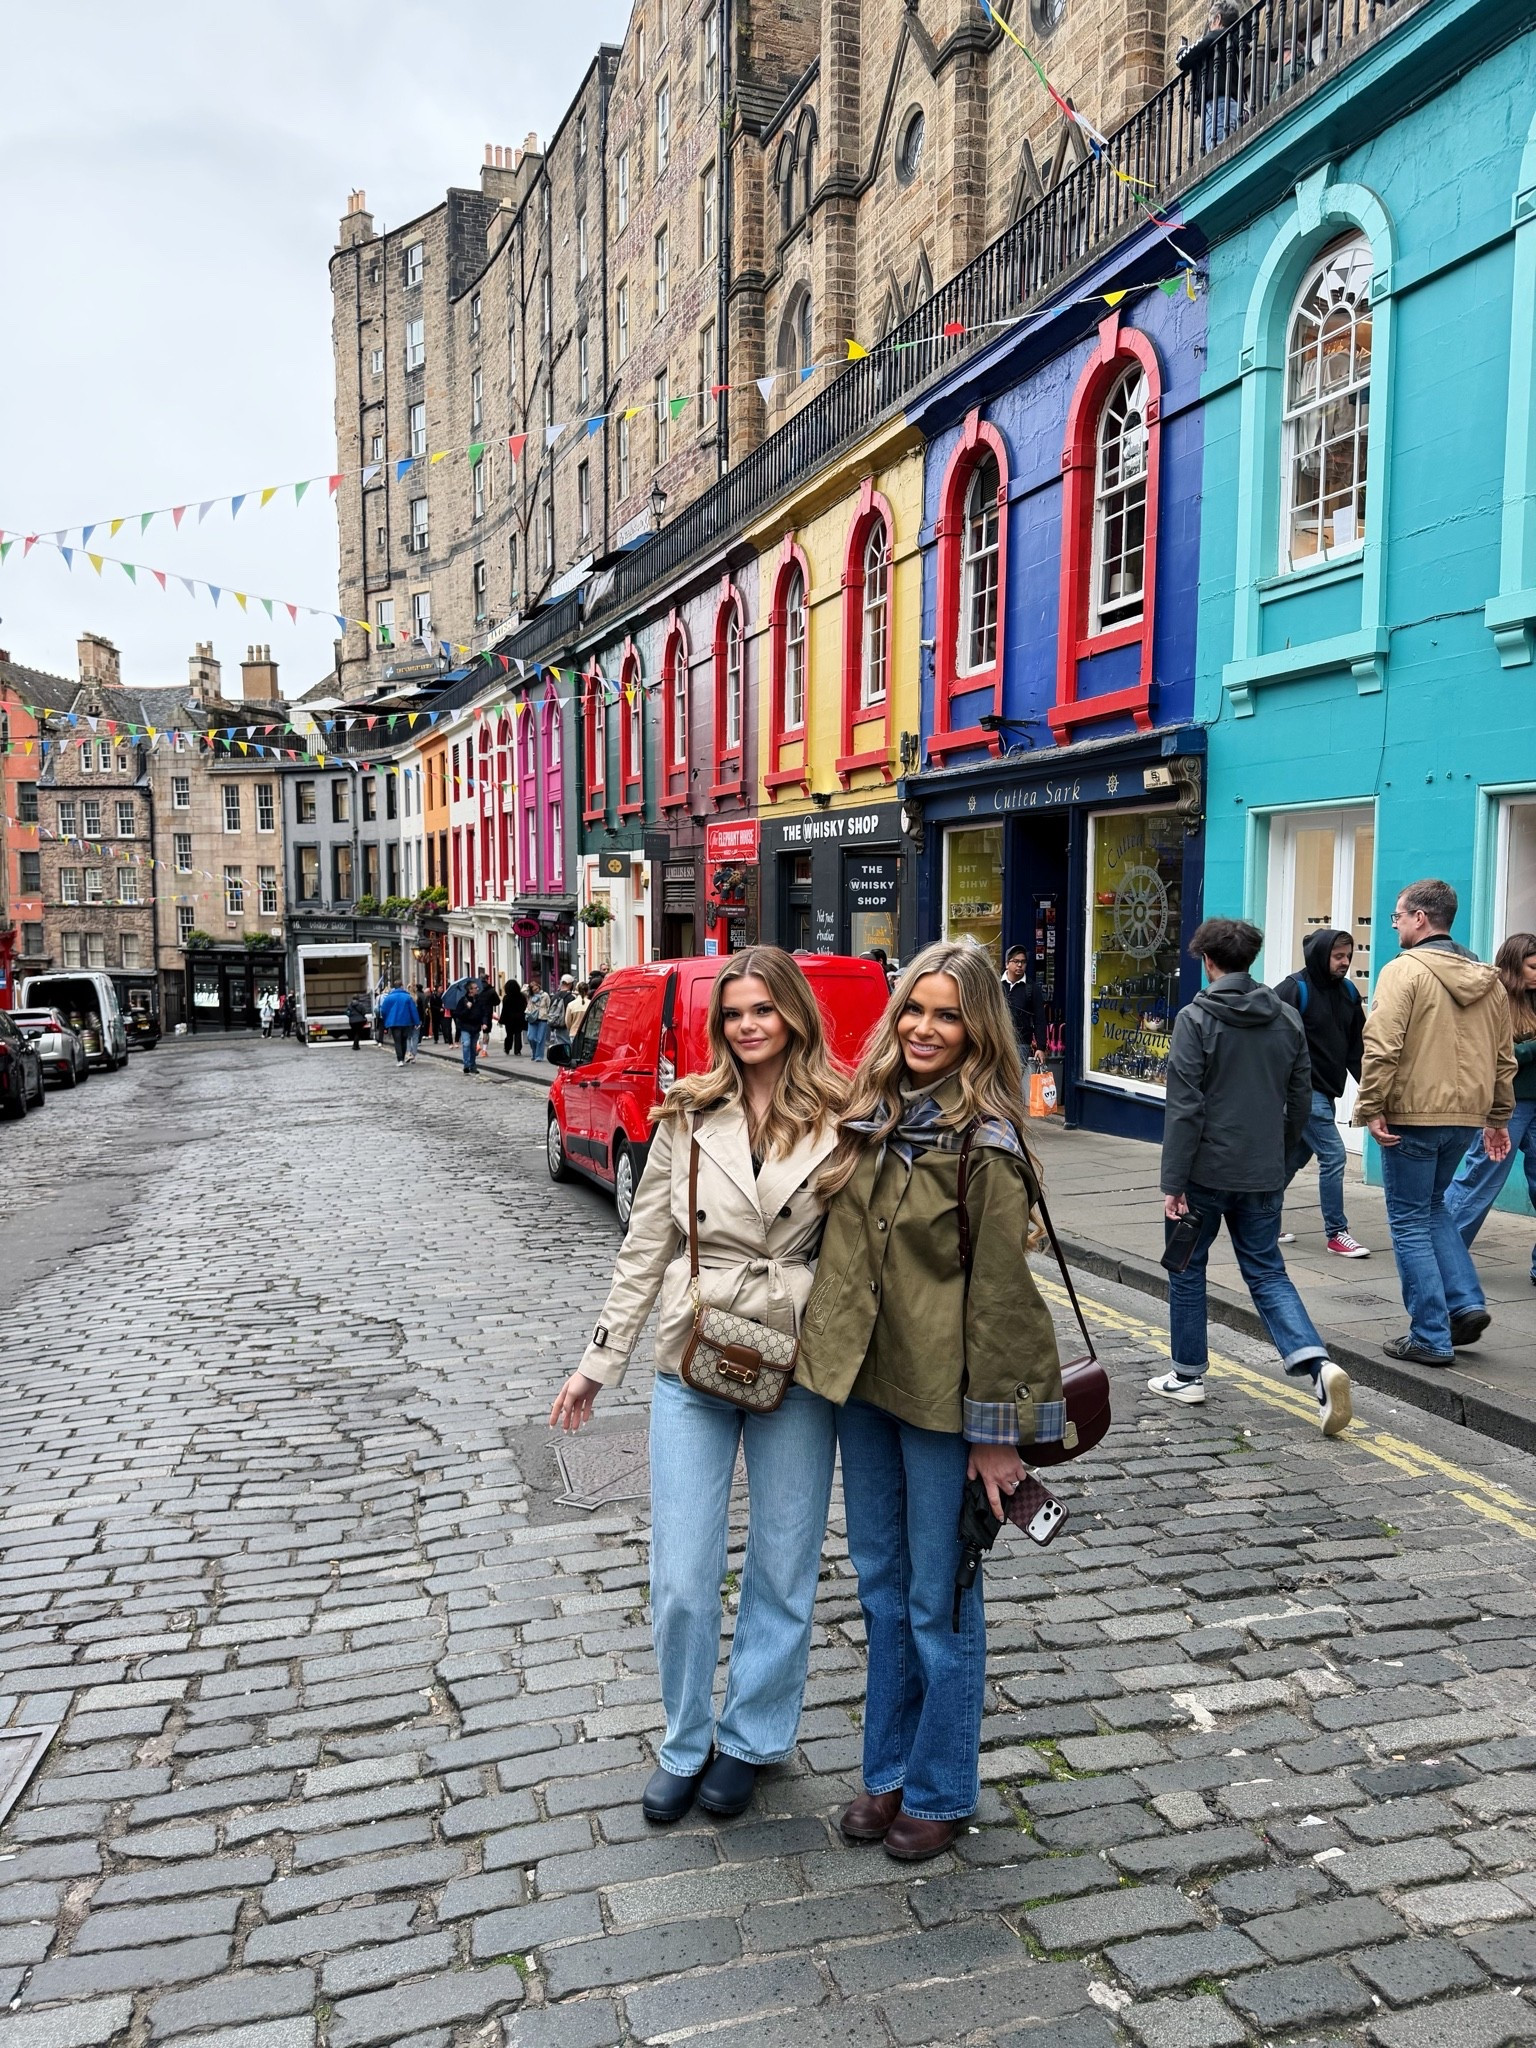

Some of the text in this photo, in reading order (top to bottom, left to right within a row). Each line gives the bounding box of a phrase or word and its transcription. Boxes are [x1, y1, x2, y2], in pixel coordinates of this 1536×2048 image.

[994, 778, 1081, 810] Cuttea Sark
[718, 831, 740, 848] ELEPHANT
[739, 828, 755, 846] HOUSE
[783, 815, 879, 842] THE WHISKY SHOP
[861, 865, 883, 874] THE
[850, 880, 895, 891] WHISKY
[857, 896, 887, 905] SHOP
[1102, 1020, 1172, 1050] Merchants
